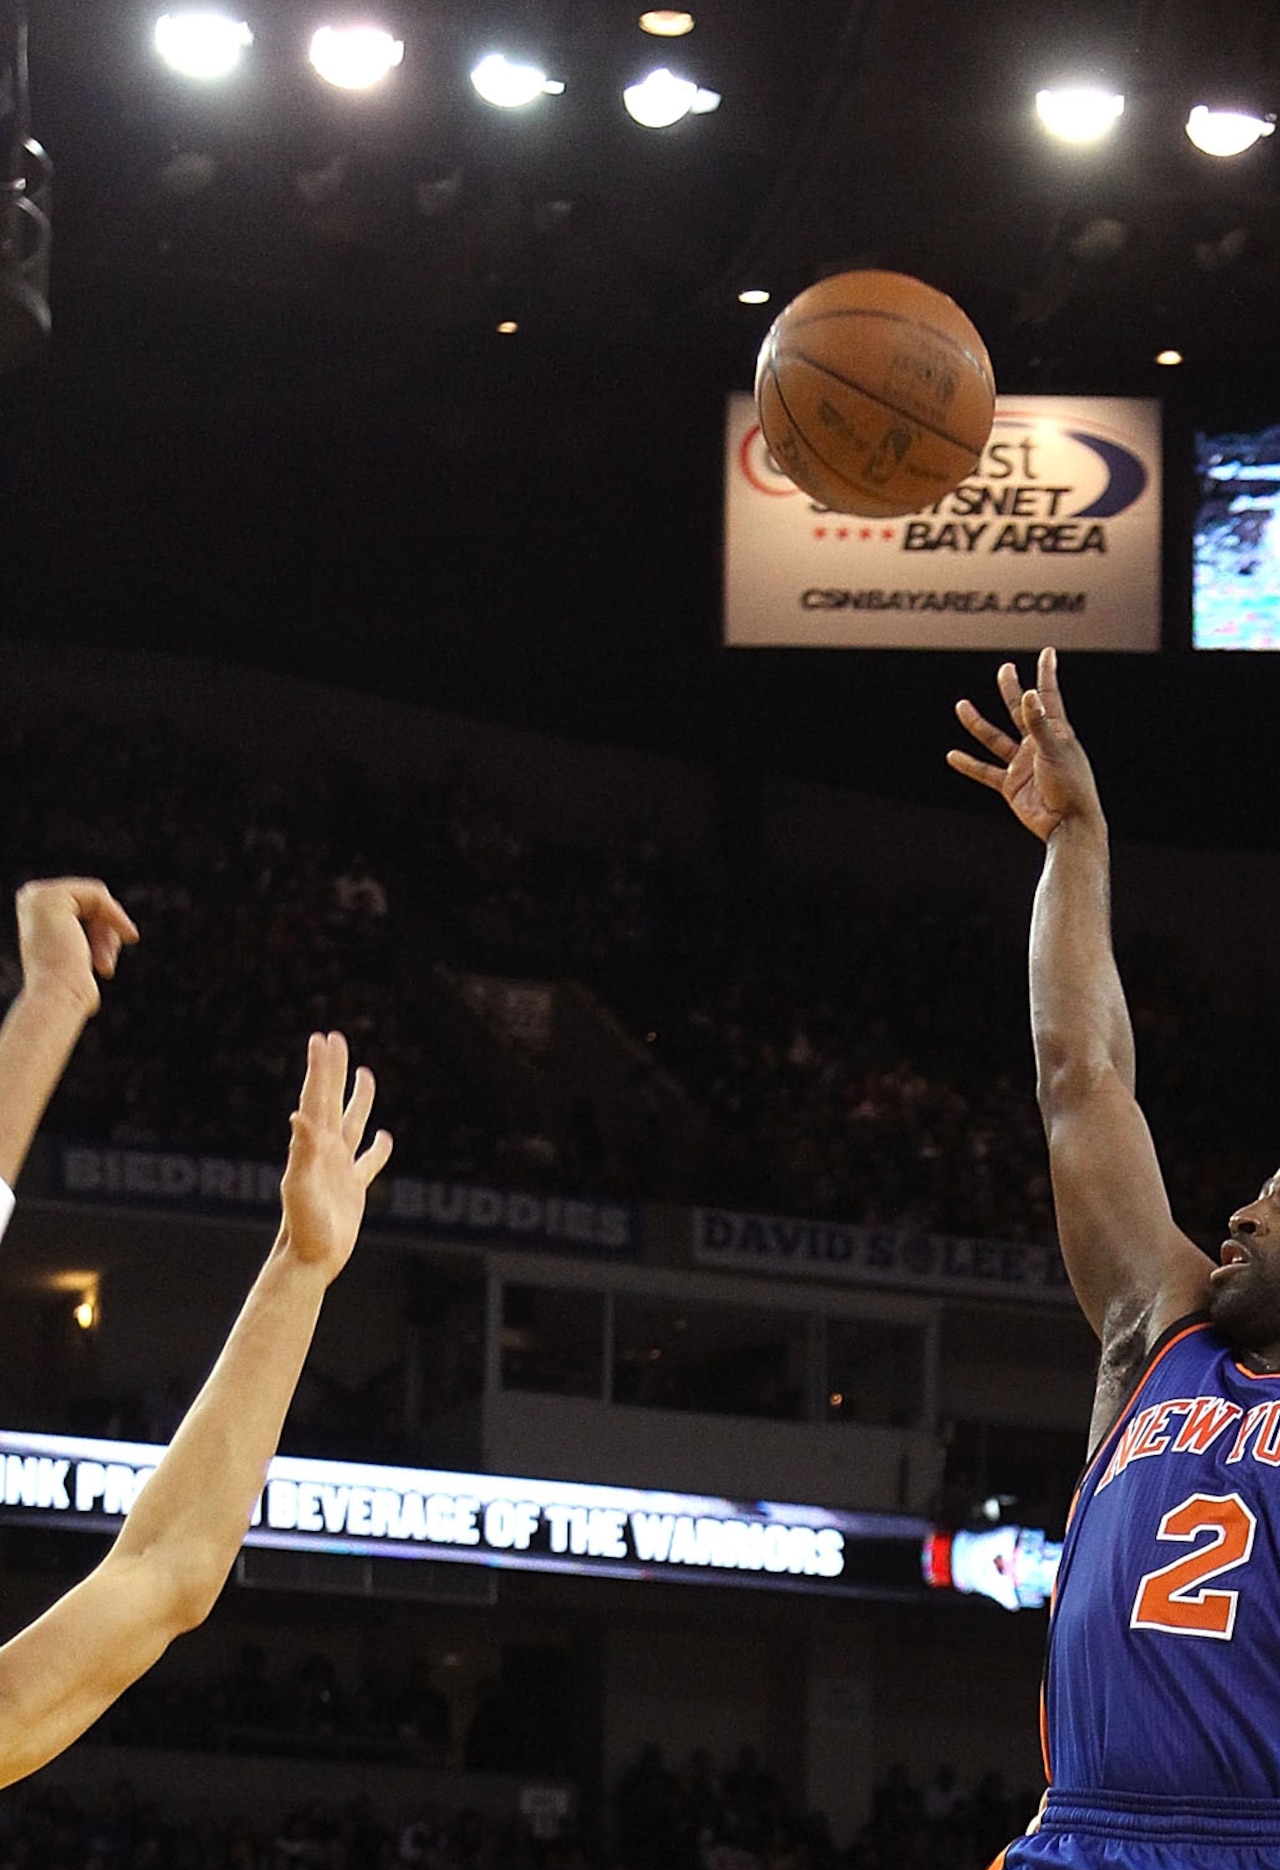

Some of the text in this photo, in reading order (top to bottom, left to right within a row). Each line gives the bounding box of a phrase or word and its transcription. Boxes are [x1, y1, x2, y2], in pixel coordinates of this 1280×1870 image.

[903, 523, 1107, 553] BAY AREA
[389, 1176, 629, 1247] BUDDIES
[1093, 1396, 1243, 1497] NEW
[267, 1479, 481, 1546] BEVERAGE
[484, 1499, 541, 1550] OF
[545, 1504, 628, 1559] THE
[630, 1512, 845, 1577] WARRIORS
[1129, 1492, 1257, 1641] 2
